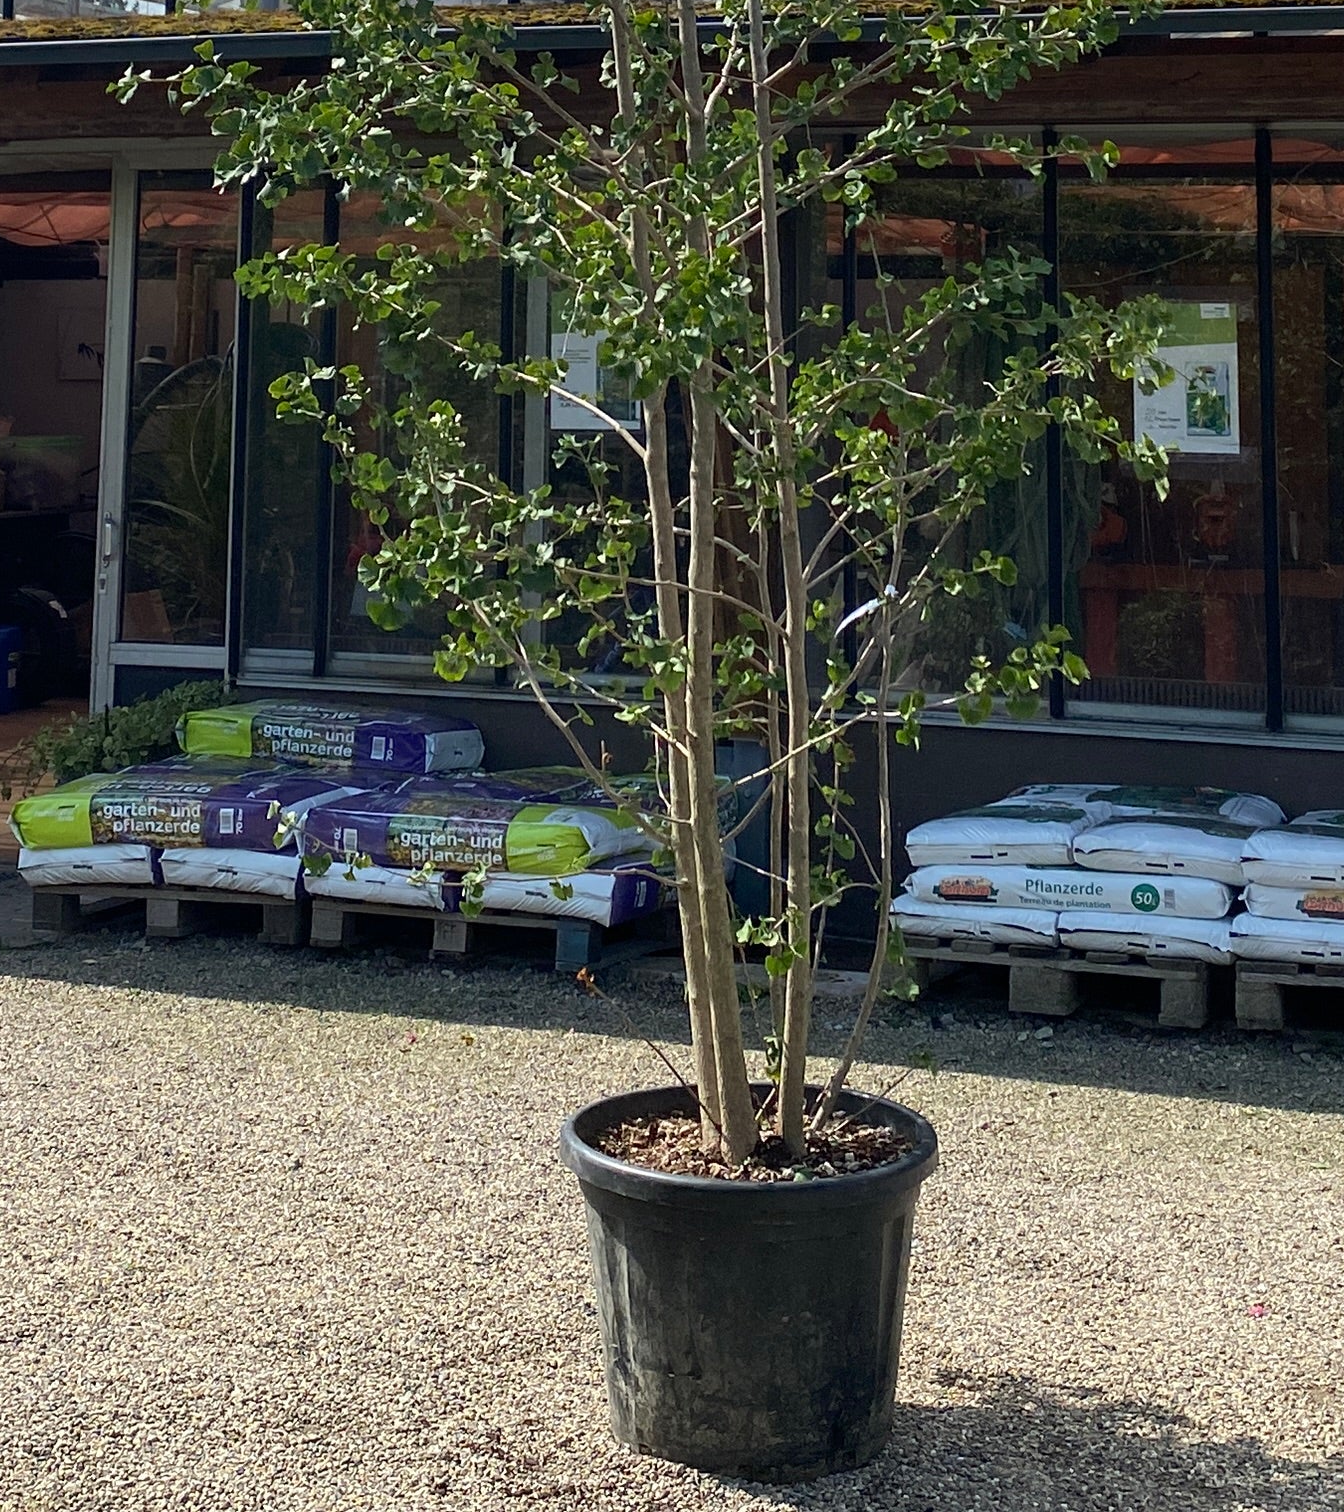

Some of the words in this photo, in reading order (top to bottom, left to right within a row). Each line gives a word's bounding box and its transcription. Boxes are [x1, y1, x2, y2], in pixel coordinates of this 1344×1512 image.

[264, 723, 320, 740] garten-
[326, 729, 355, 744] und
[272, 737, 353, 758] pflanzerde
[104, 804, 165, 820] garten-
[171, 802, 201, 818] und
[112, 818, 201, 835] pflanzerde
[401, 829, 465, 849] garten-
[470, 833, 503, 849] und
[411, 847, 503, 865] pflanzerde
[1025, 879, 1104, 896] Pflanzerde
[1066, 899, 1112, 910] plantation
